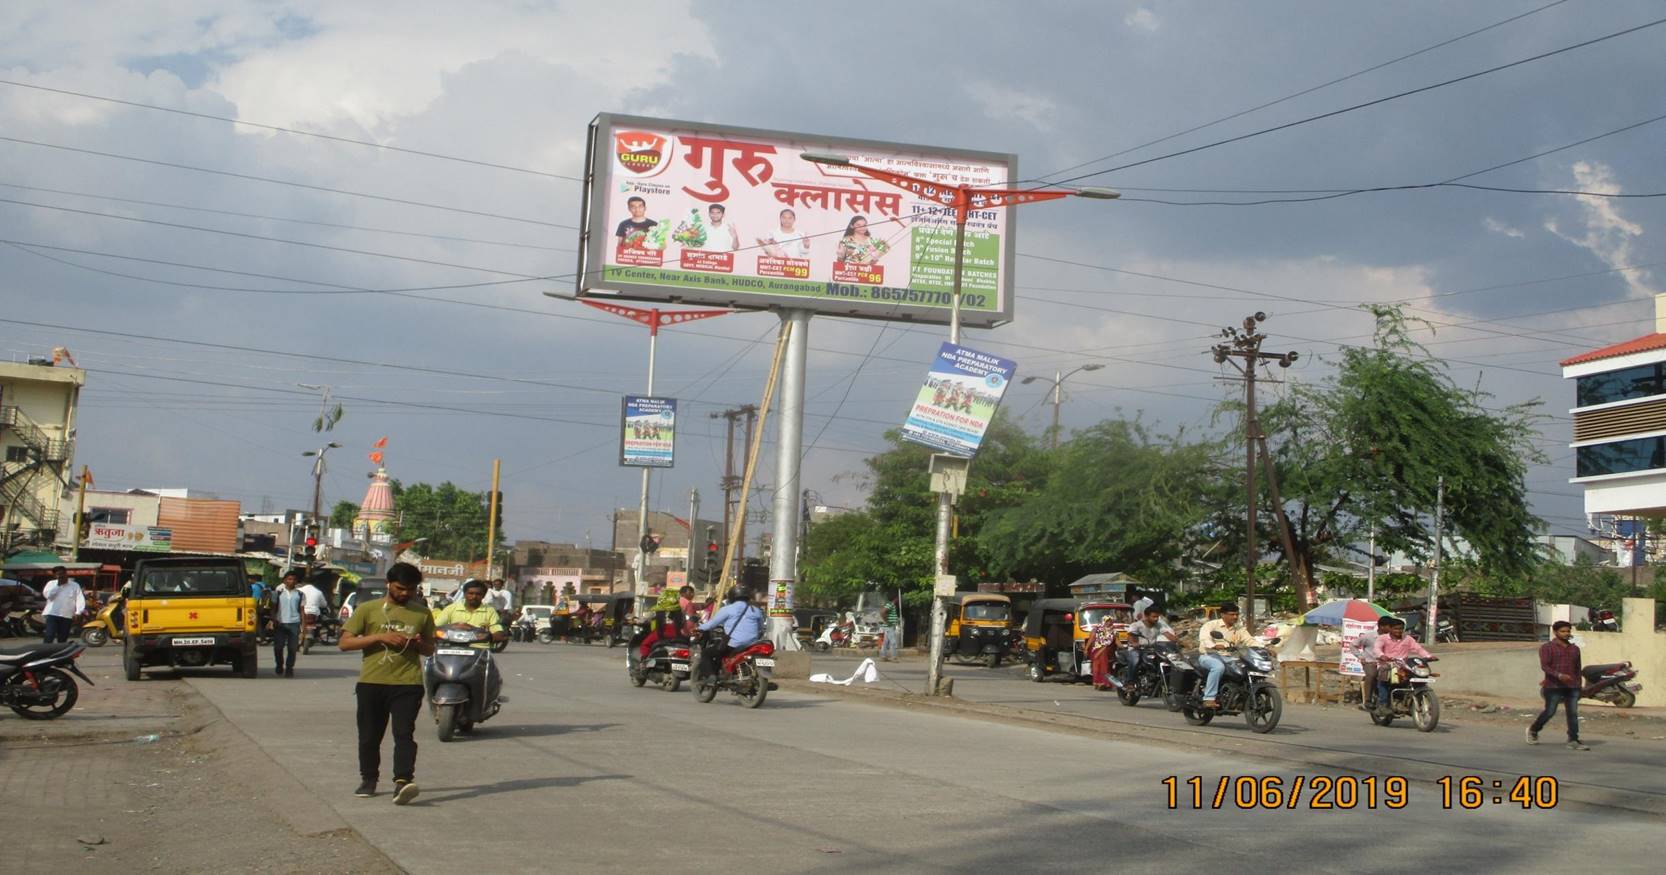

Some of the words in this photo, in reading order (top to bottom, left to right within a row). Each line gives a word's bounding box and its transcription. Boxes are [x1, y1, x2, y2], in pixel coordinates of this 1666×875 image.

[621, 153, 658, 164] GURU
[634, 185, 671, 195] Playstore
[968, 210, 997, 221] HT-CET
[950, 248, 971, 256] Bch
[945, 255, 972, 264] Relar
[795, 267, 807, 276] 99
[924, 267, 965, 276] FOUNDAT
[869, 273, 881, 283] 96
[624, 269, 656, 280] Center,
[660, 272, 680, 281] Near
[683, 274, 701, 283] Axis
[703, 276, 729, 286] Bank,
[732, 278, 765, 289] HUDCO,
[768, 281, 821, 293] Aurangabad
[871, 286, 986, 308] 865757770/02
[956, 348, 976, 360] ATMA
[976, 354, 1000, 366] MALIK
[941, 352, 957, 361] NDA
[957, 356, 1008, 374] PREPARATORY
[954, 363, 988, 377] ACADEMY
[915, 404, 955, 421] PREPRATION
[955, 414, 969, 424] FOR
[969, 418, 984, 429] NDA
